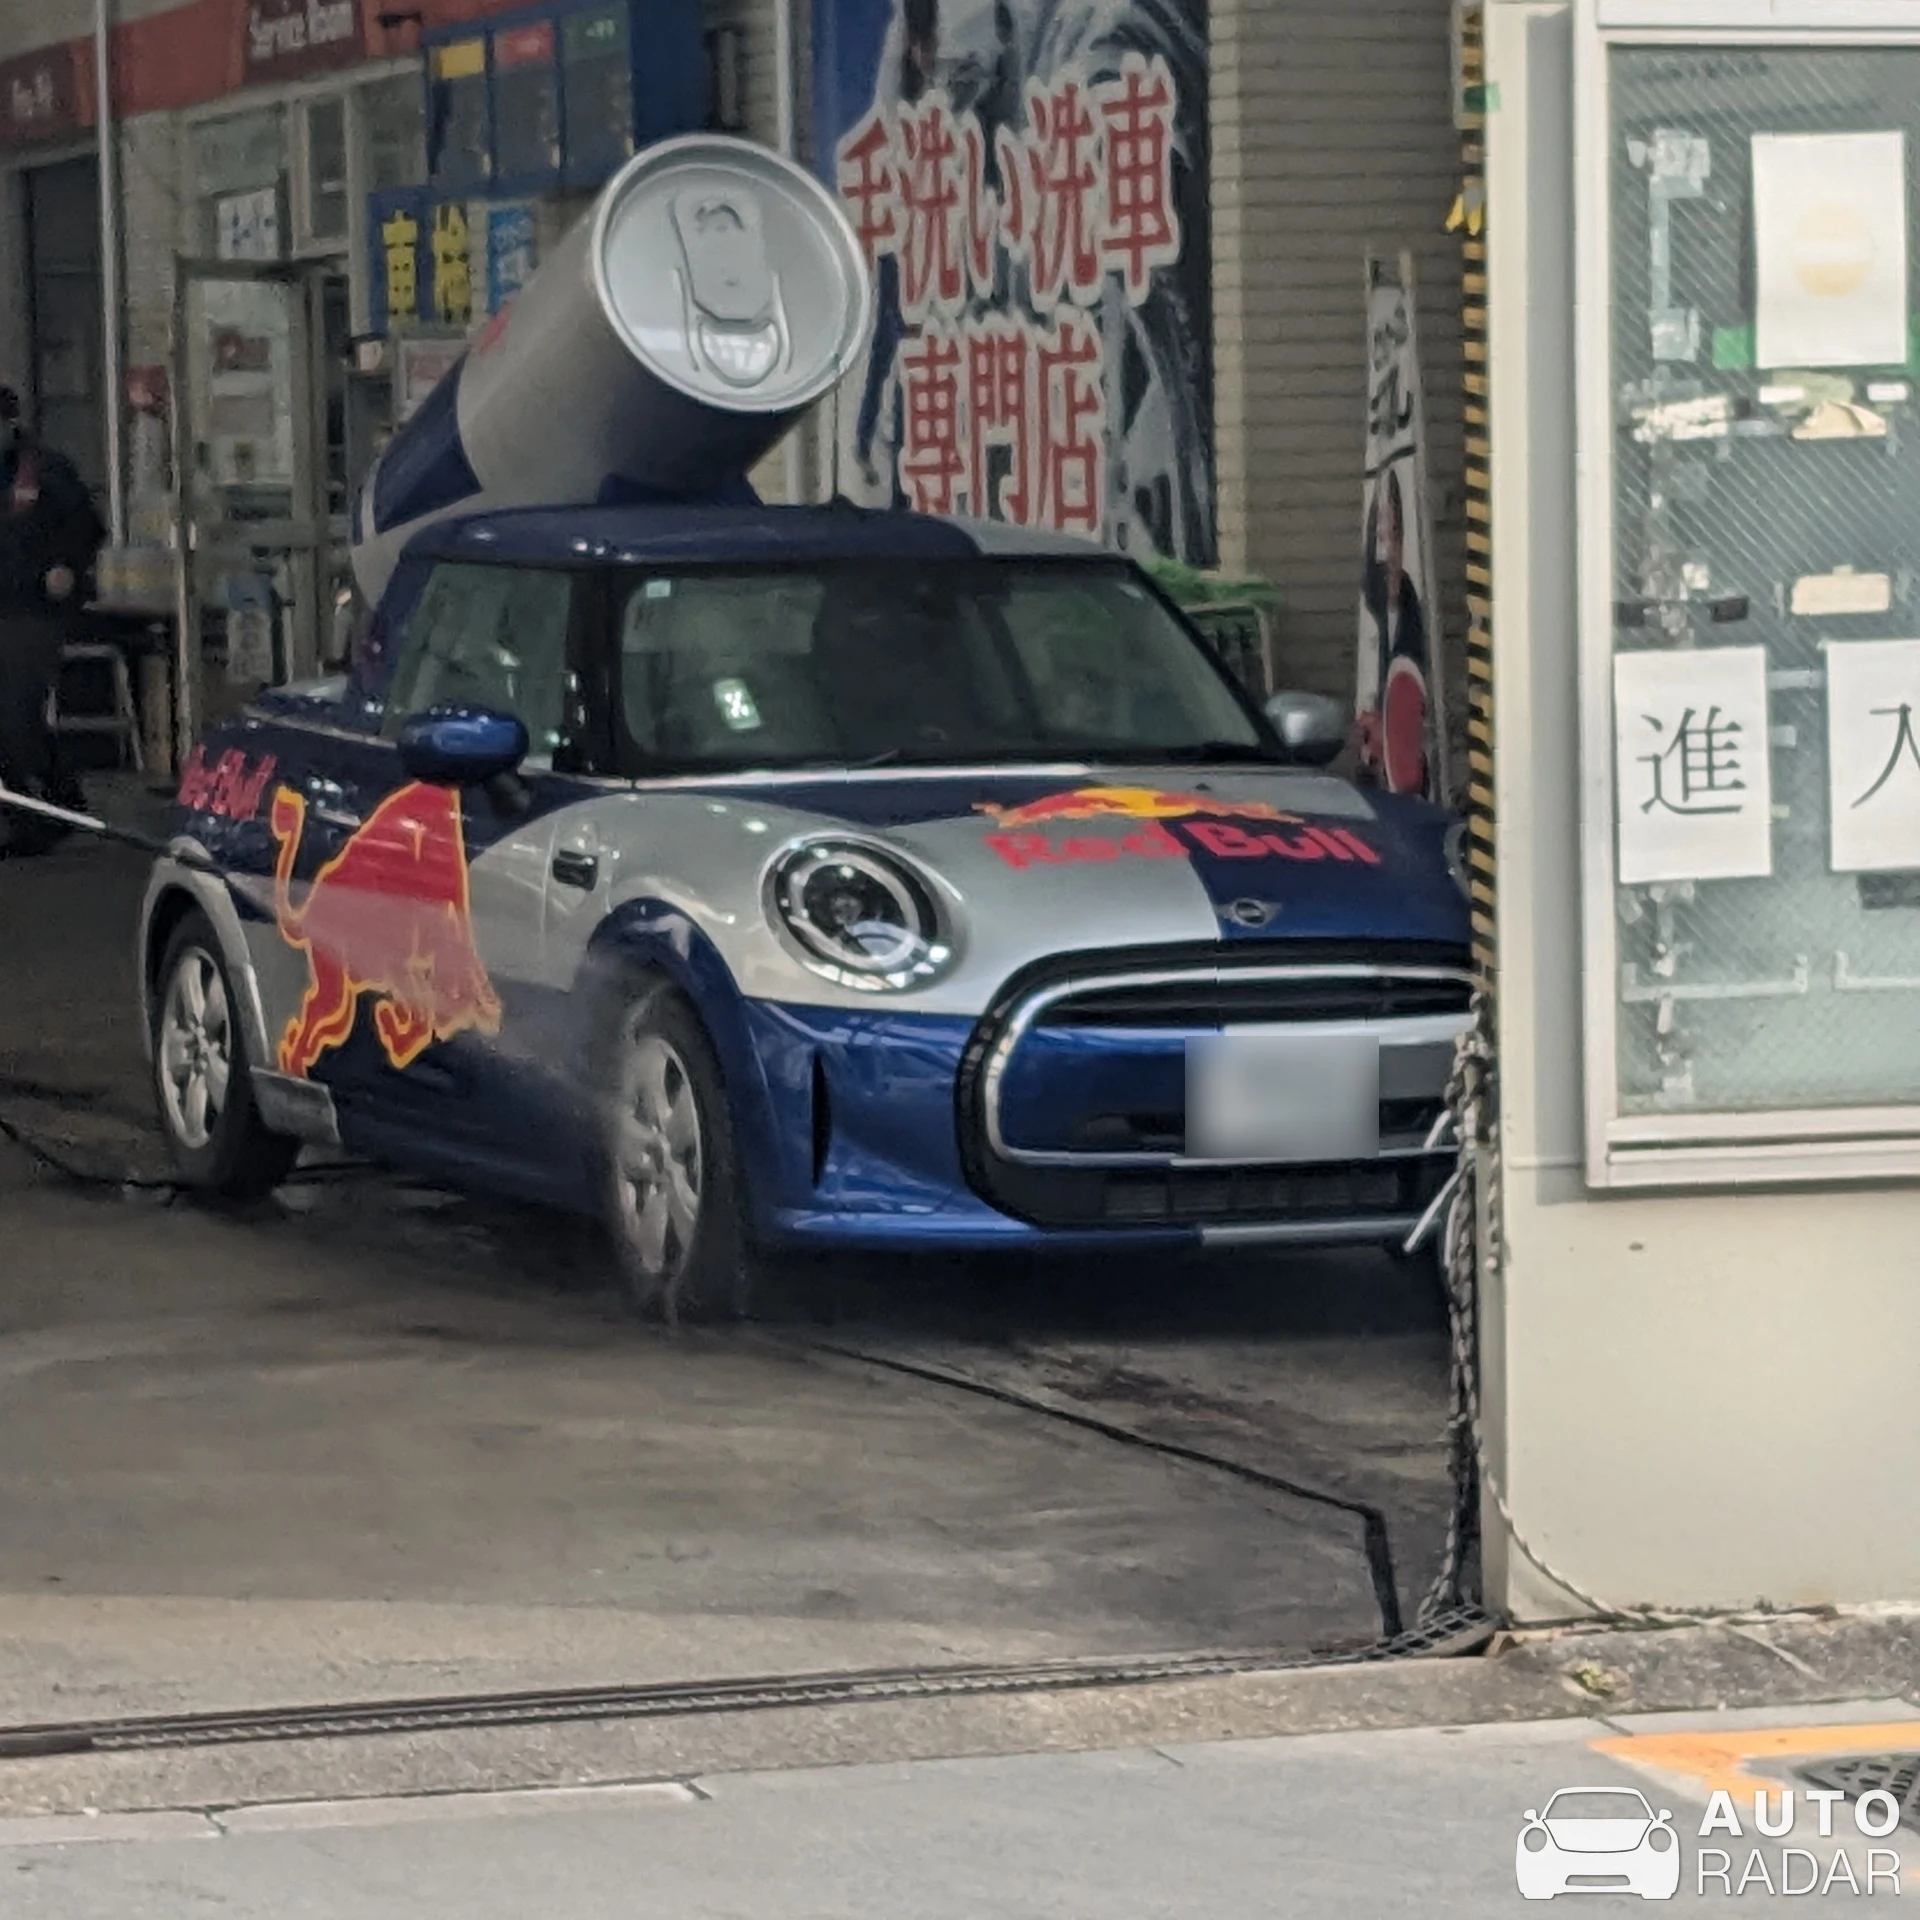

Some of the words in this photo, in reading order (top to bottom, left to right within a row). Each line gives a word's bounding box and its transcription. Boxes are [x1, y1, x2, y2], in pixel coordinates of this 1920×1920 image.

[841, 72, 1173, 303] 手洗い洗車
[903, 322, 1099, 531] 専門店
[985, 818, 1191, 871] Red
[1181, 820, 1381, 865] Bull
